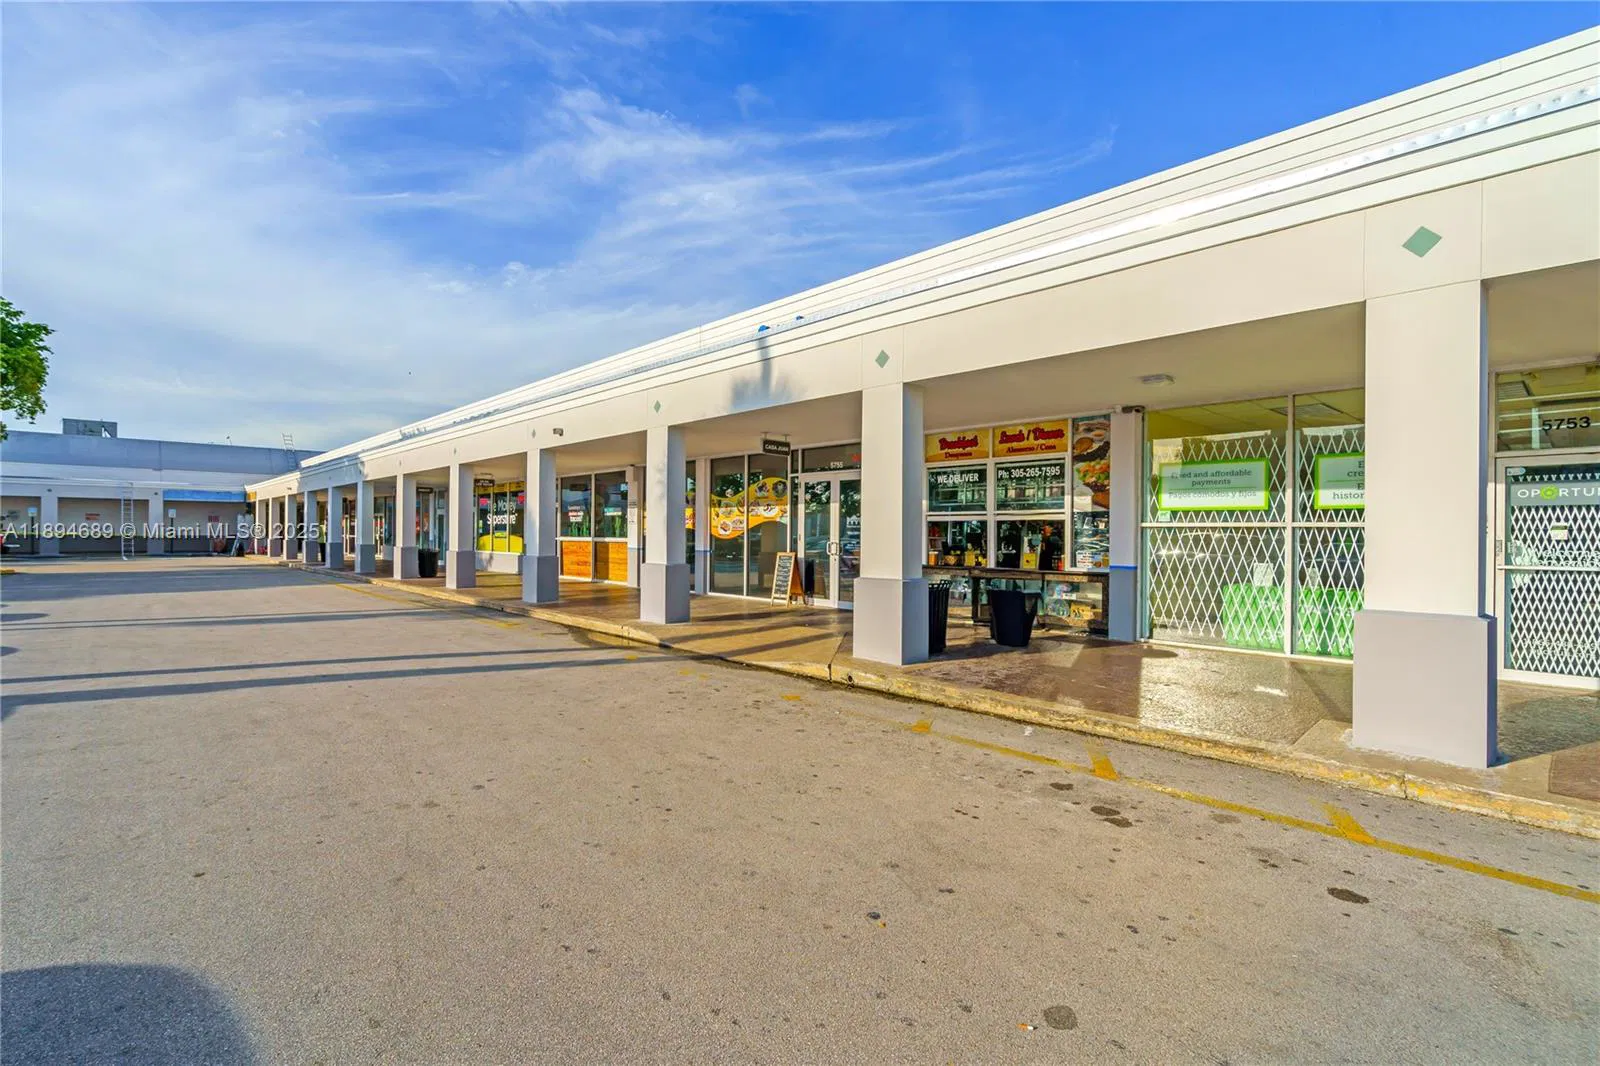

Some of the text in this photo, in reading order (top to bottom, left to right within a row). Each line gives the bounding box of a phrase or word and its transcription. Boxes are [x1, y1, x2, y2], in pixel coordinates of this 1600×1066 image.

[1542, 416, 1591, 431] 5753
[937, 473, 979, 484] WE DELIVER
[998, 466, 1061, 479] Ph: 305-265-7595
[1193, 470, 1209, 478] and
[1210, 469, 1253, 477] affordable
[1191, 479, 1232, 488] payments
[1517, 485, 1600, 499] OPORTU
